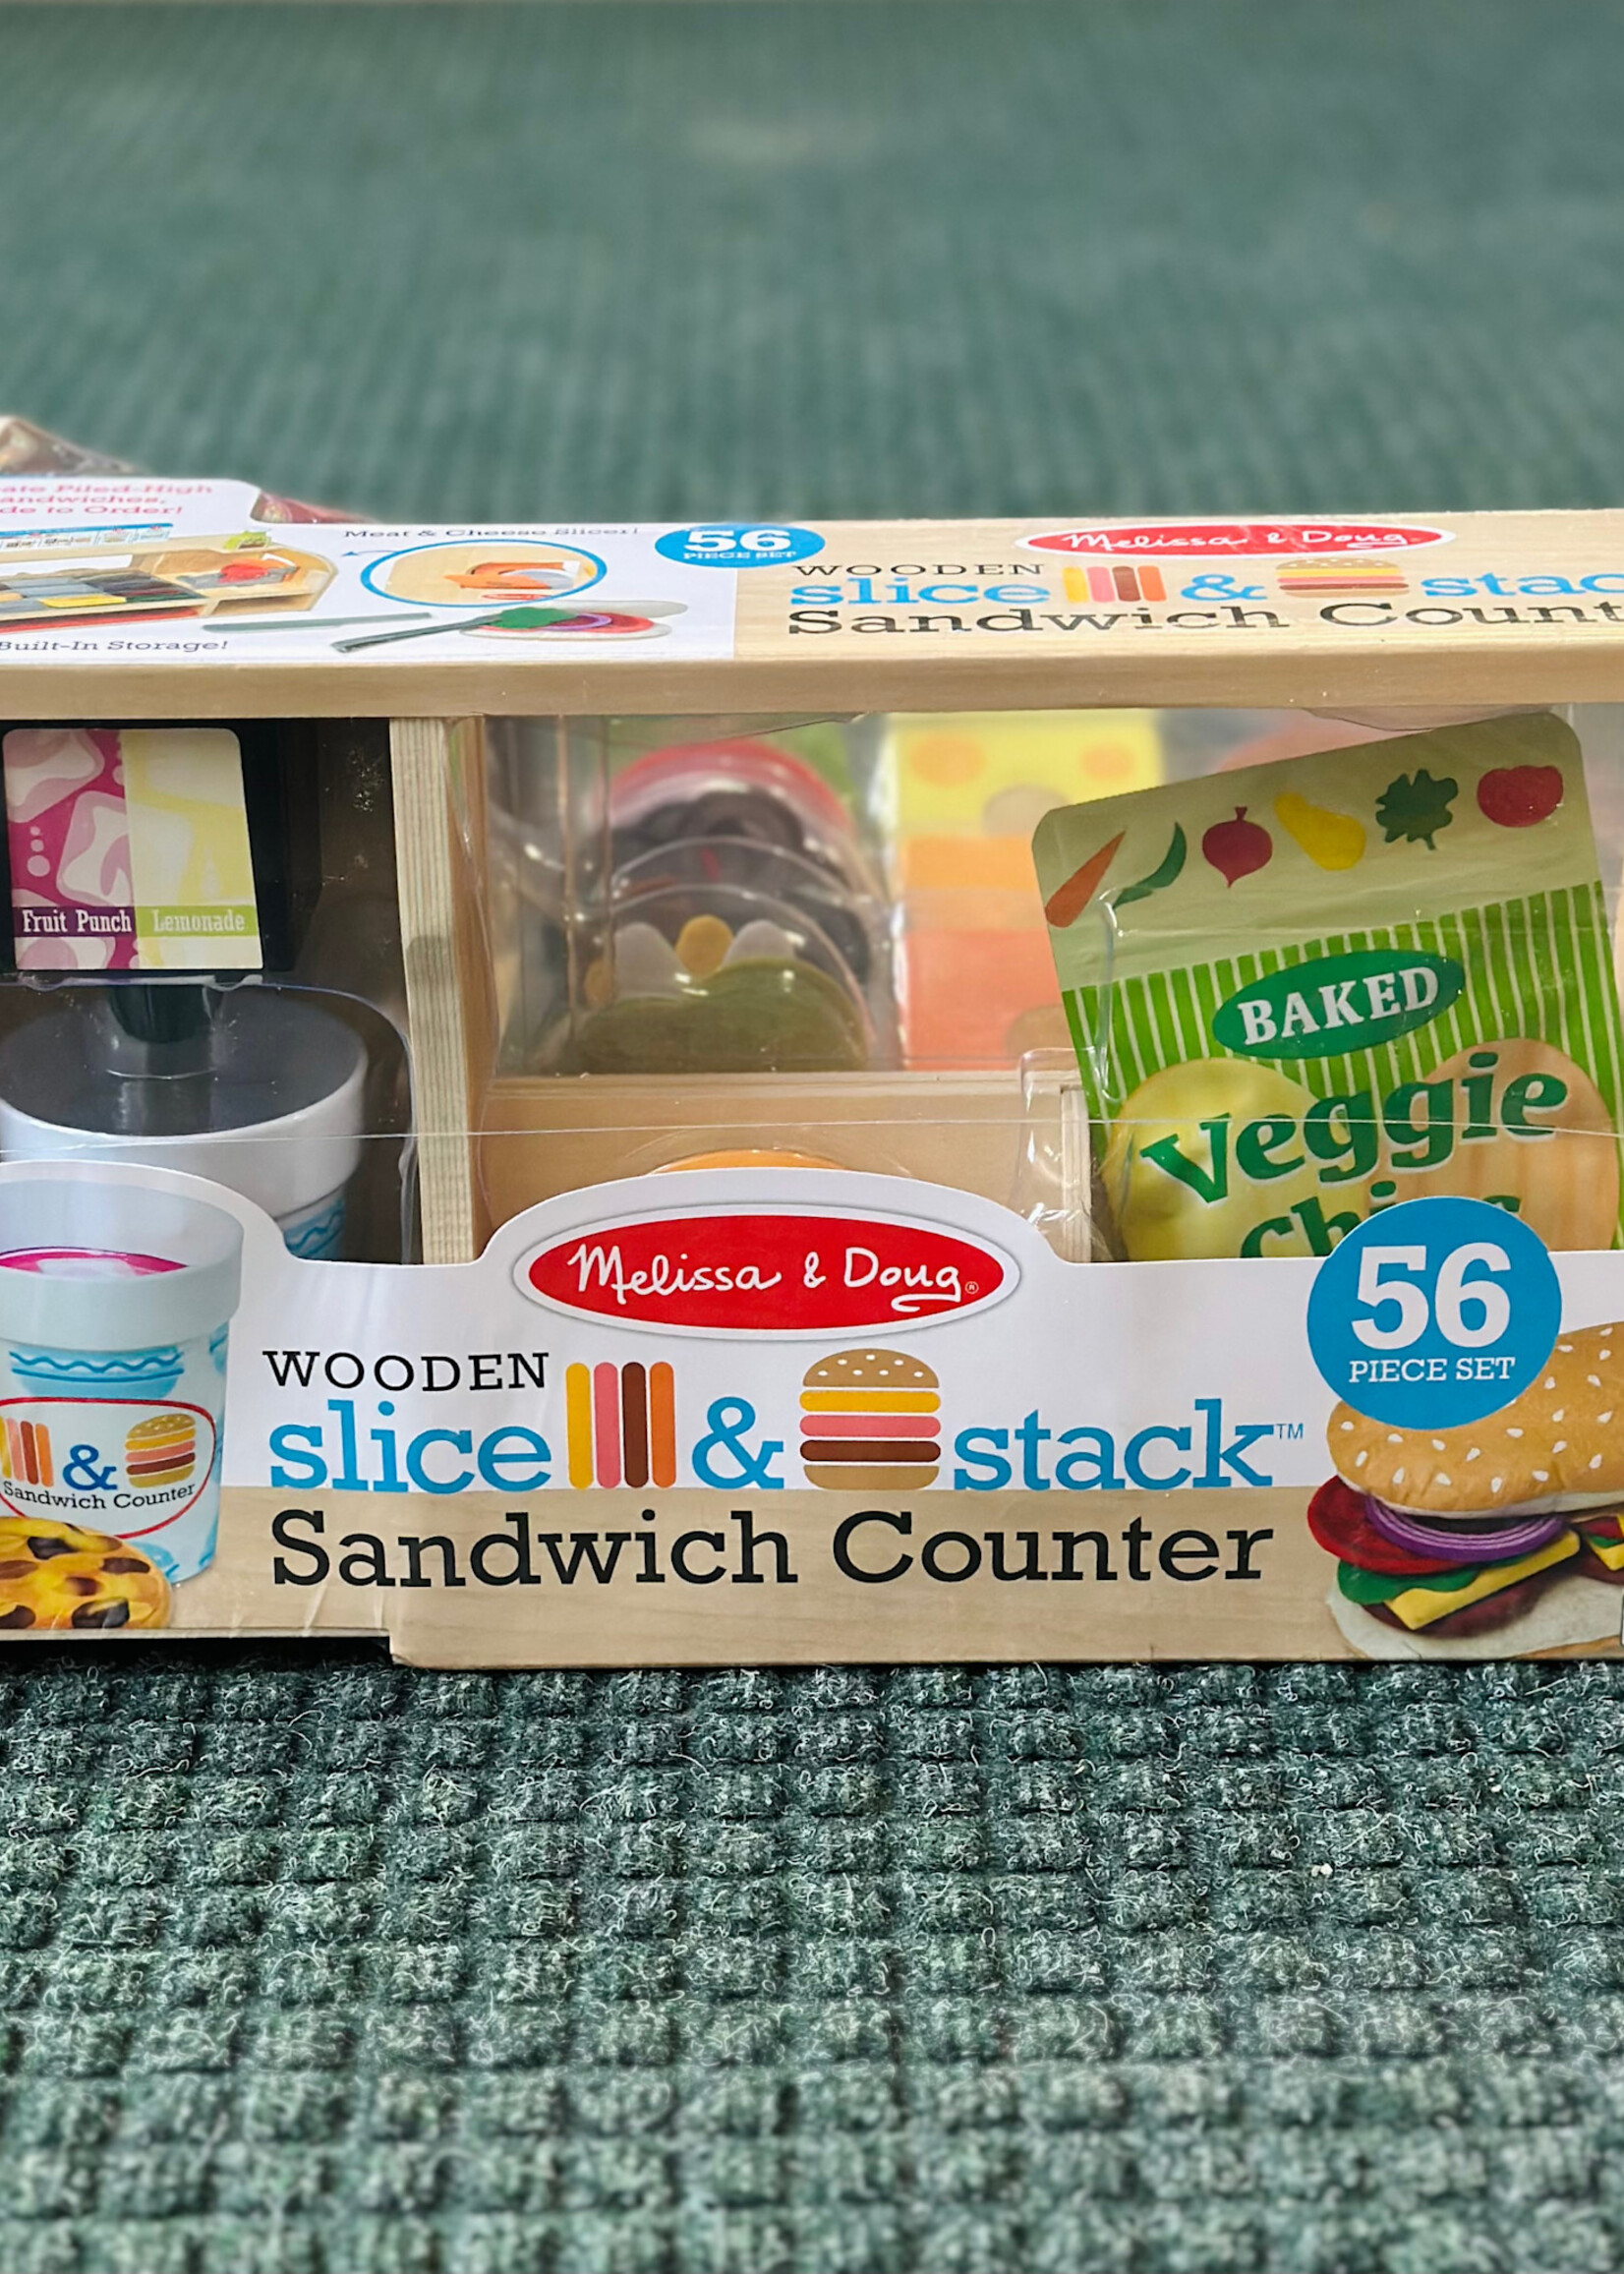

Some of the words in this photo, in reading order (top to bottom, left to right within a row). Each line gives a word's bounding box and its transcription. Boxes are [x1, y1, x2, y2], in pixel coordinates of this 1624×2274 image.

[85, 505, 183, 515] Order!
[554, 527, 638, 536] Slicer!
[683, 529, 791, 553] 56
[1063, 532, 1247, 552] Melissa
[1267, 532, 1286, 544] &
[792, 563, 1045, 577] WOODEN
[790, 577, 1050, 605] slice
[1181, 574, 1268, 603] &
[788, 606, 1290, 635] Sandwich
[0, 640, 98, 651] Built-In
[107, 640, 229, 653] Storage!
[23, 909, 67, 933] Fruit
[77, 909, 132, 933] Punch
[153, 909, 245, 933] Lemonade
[1238, 965, 1439, 1046] BAKED
[1139, 1052, 1568, 1205] Veggie
[568, 1244, 783, 1304] Melissa
[803, 1251, 827, 1289] &
[1351, 1242, 1511, 1351] 56
[262, 1350, 550, 1392] WOODEN
[1349, 1358, 1448, 1383] PIECE
[1455, 1357, 1516, 1381] SET
[269, 1400, 552, 1495] slice
[691, 1396, 784, 1489] &
[62, 1445, 117, 1491] &
[3, 1481, 106, 1509] Sandwich
[113, 1483, 196, 1509] Counter
[271, 1508, 798, 1588] Sandwich
[832, 1509, 1274, 1585] Counter
